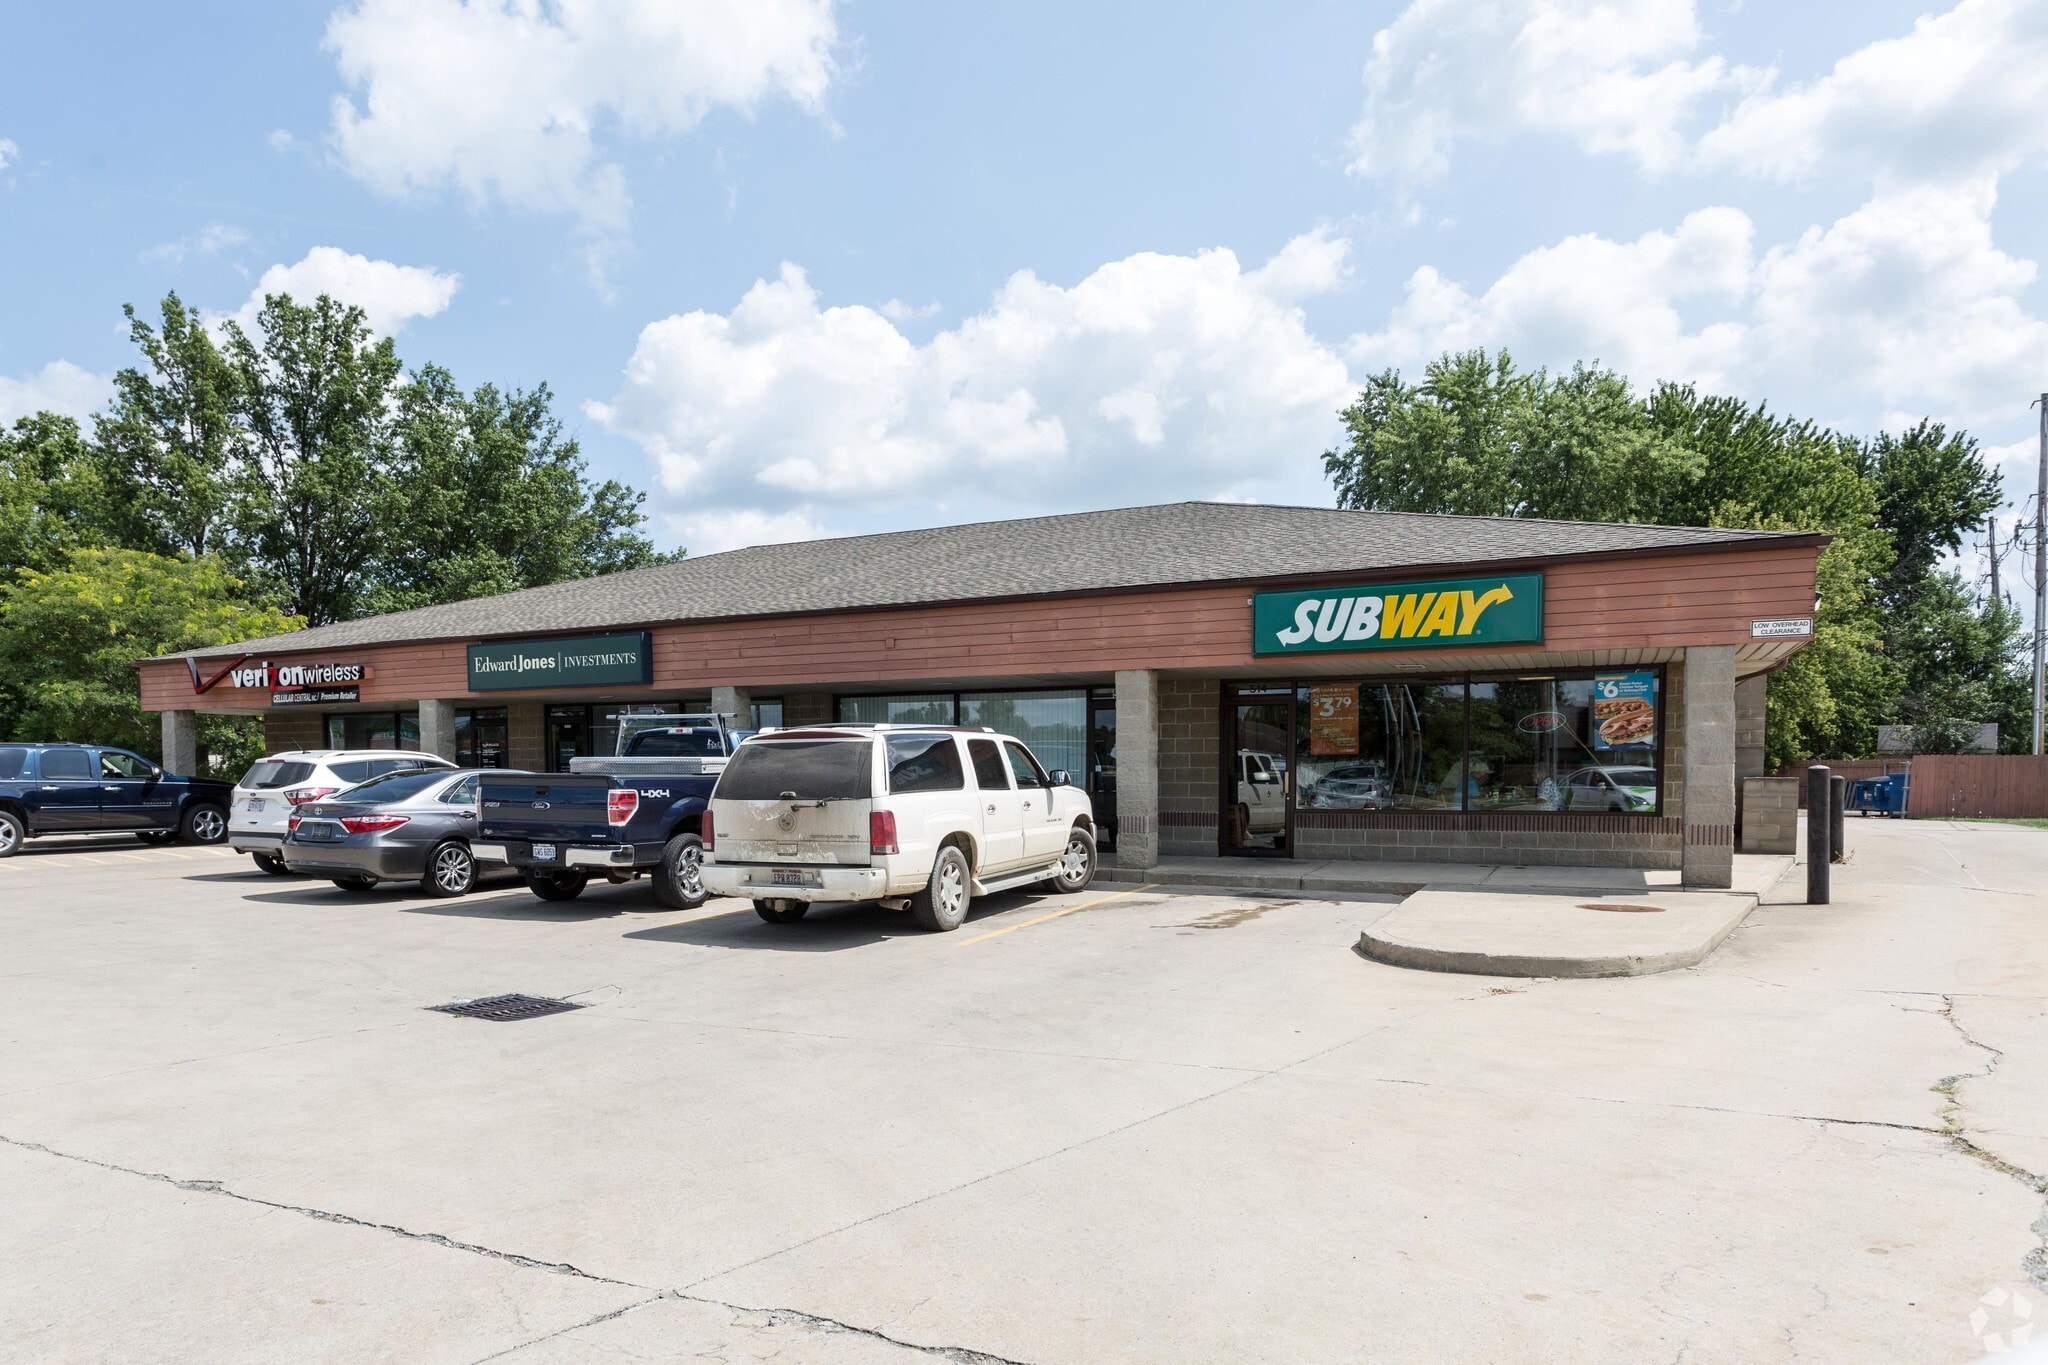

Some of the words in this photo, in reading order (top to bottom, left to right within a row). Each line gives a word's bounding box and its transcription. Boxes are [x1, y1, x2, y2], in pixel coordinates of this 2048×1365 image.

[1276, 583, 1514, 647] SUBWAY
[474, 655, 517, 673] Edward
[517, 654, 556, 673] Jones
[564, 652, 637, 668] INVESTMENTS
[1597, 681, 1618, 698] $6
